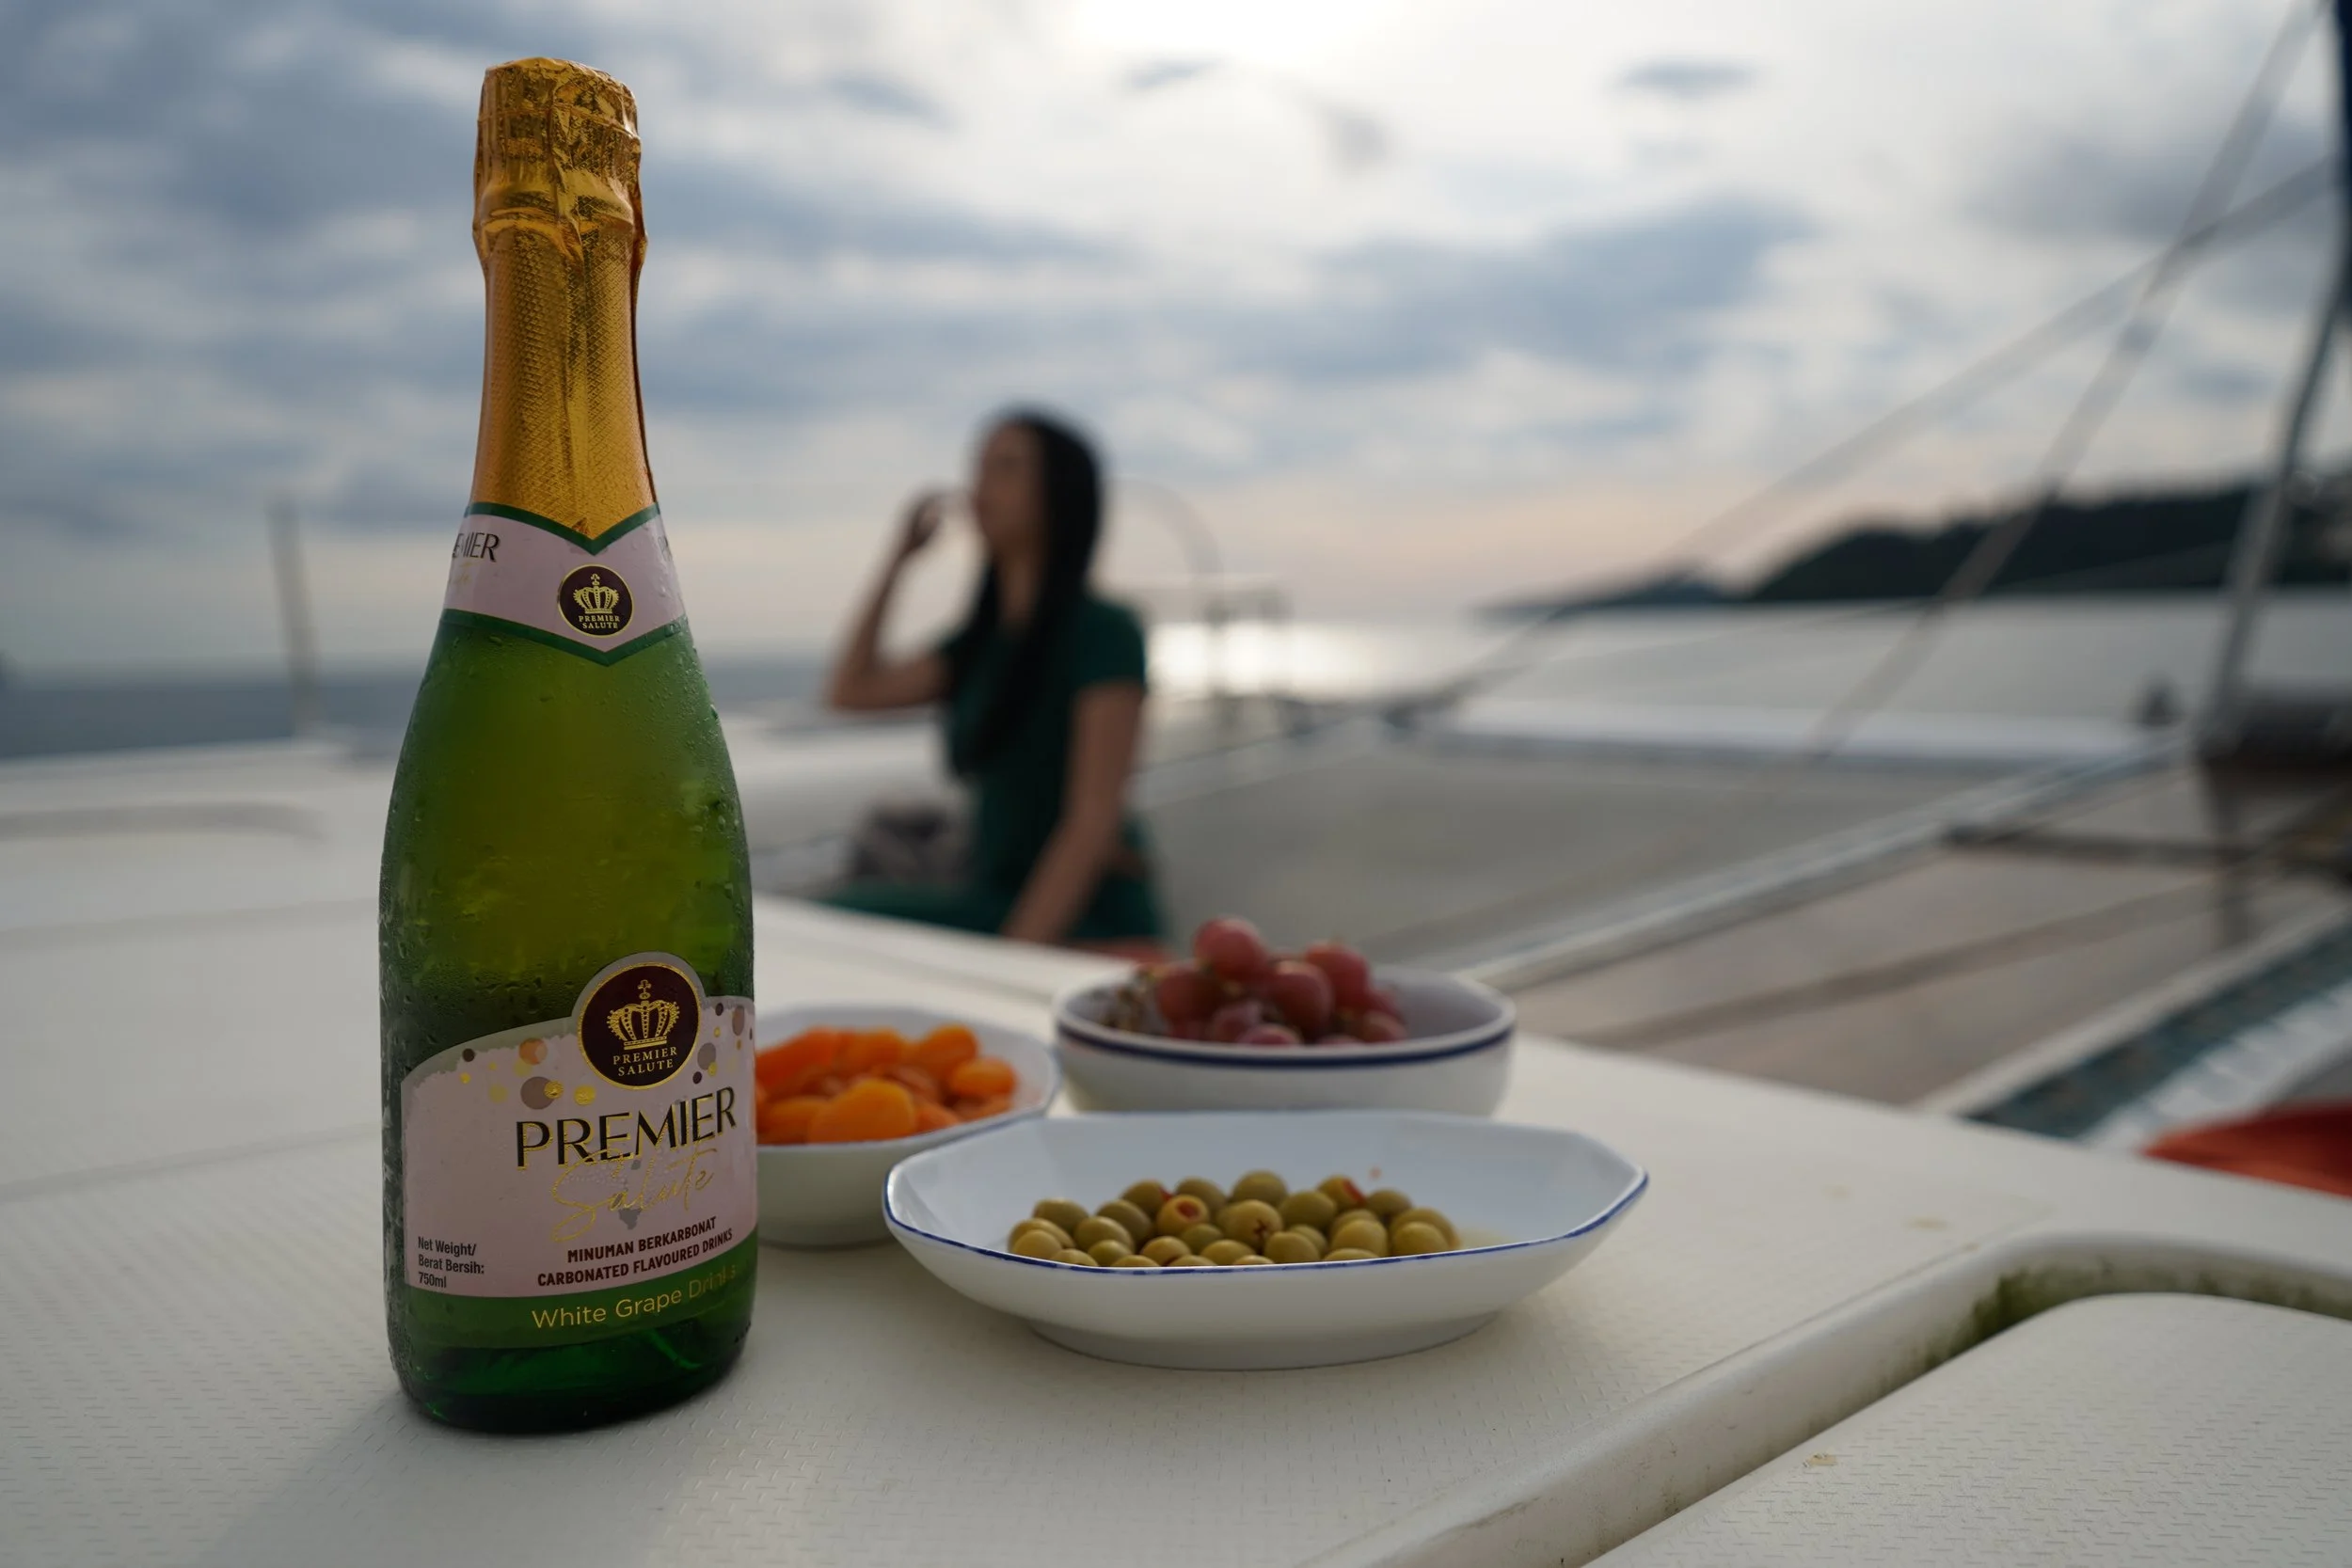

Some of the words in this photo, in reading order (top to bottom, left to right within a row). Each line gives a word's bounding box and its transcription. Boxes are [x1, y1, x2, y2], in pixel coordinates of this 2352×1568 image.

[579, 614, 621, 624] PREMIER
[612, 1046, 677, 1066] PREMIER
[617, 1059, 674, 1077] SALUTE
[516, 1086, 738, 1172] PREMIER
[549, 1147, 718, 1243] Salute
[418, 1236, 433, 1251] Net
[436, 1239, 477, 1257] Weight/
[567, 1241, 634, 1263] MINUMAN
[638, 1216, 717, 1253] BERKARBONAT
[418, 1254, 443, 1270] Berat
[446, 1259, 485, 1275] Bersih:
[537, 1263, 629, 1287] CARBONATED
[633, 1243, 700, 1274] FLAVOURED
[702, 1228, 733, 1254] DRINKS
[418, 1272, 447, 1288] 750ml
[532, 1307, 607, 1328] White
[615, 1290, 683, 1318] Grape
